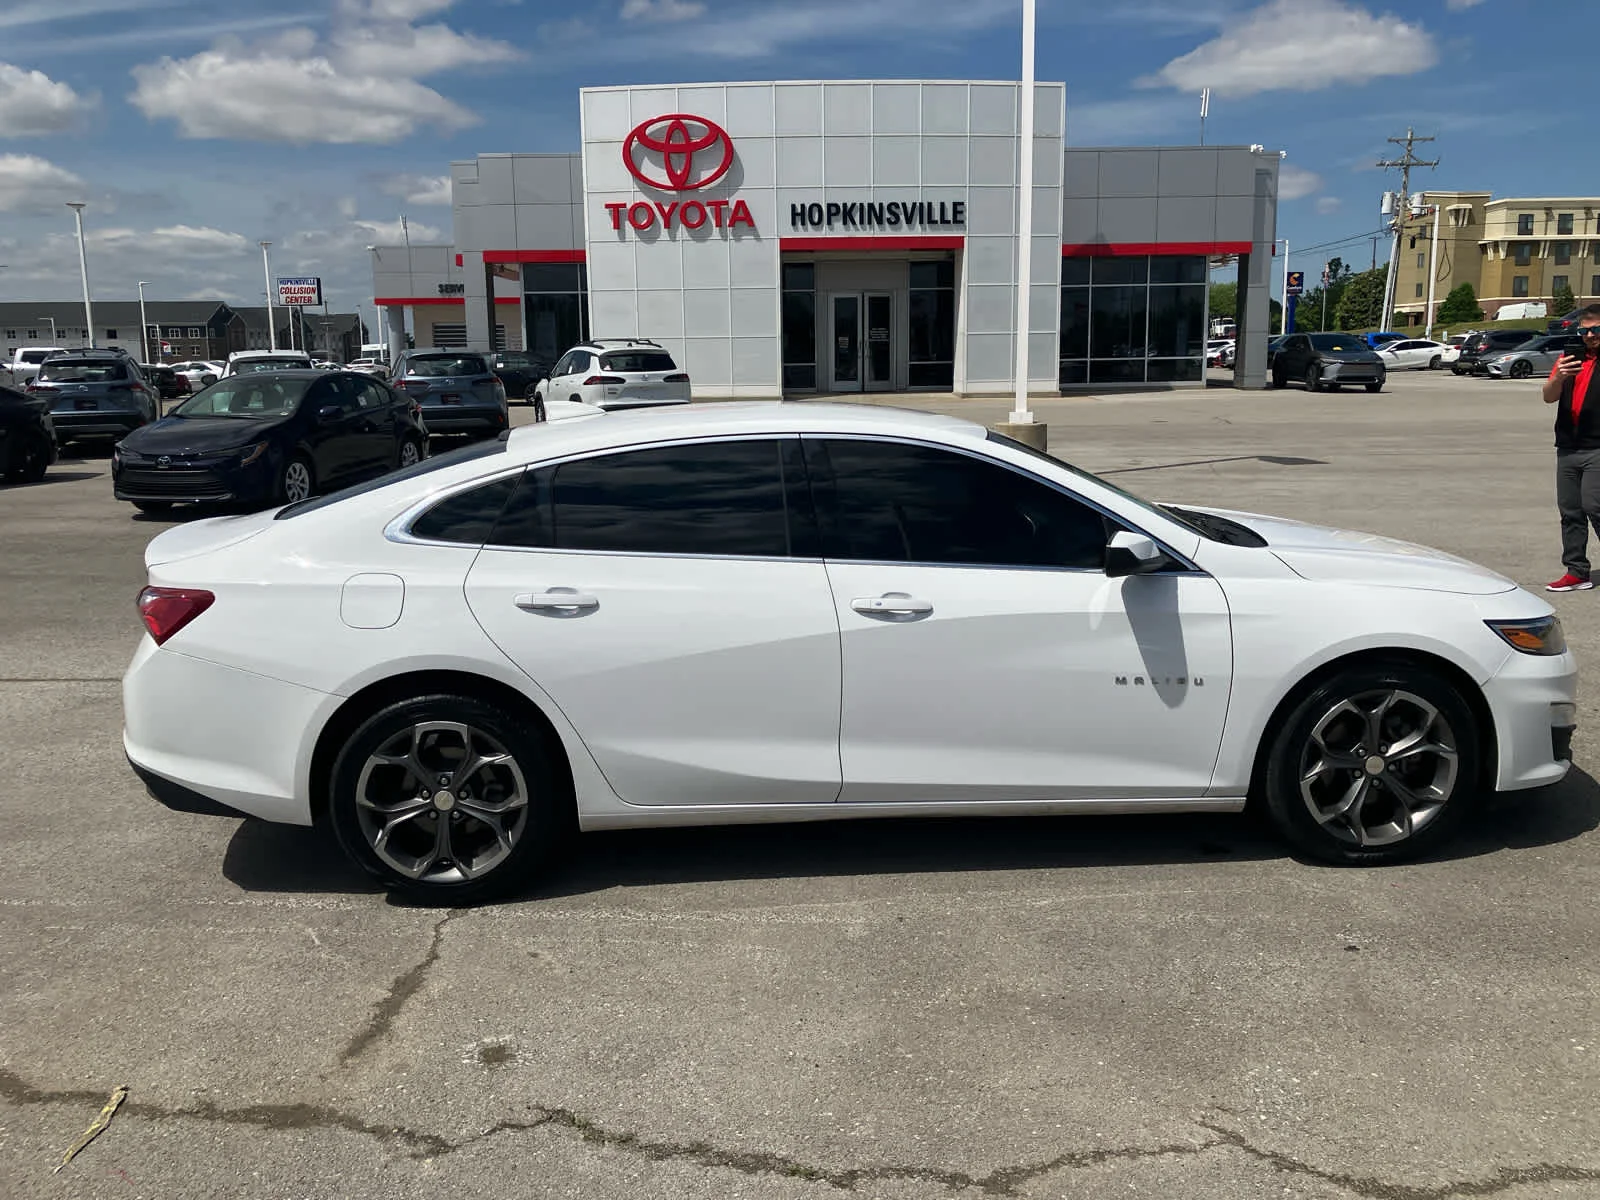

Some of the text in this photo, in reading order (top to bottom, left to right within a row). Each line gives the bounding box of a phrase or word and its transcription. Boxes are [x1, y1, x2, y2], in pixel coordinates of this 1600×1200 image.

[604, 199, 756, 231] TOYOTA
[790, 201, 966, 227] HOPKINSVILLE
[280, 286, 317, 295] COLLISION
[285, 295, 313, 304] CENTER
